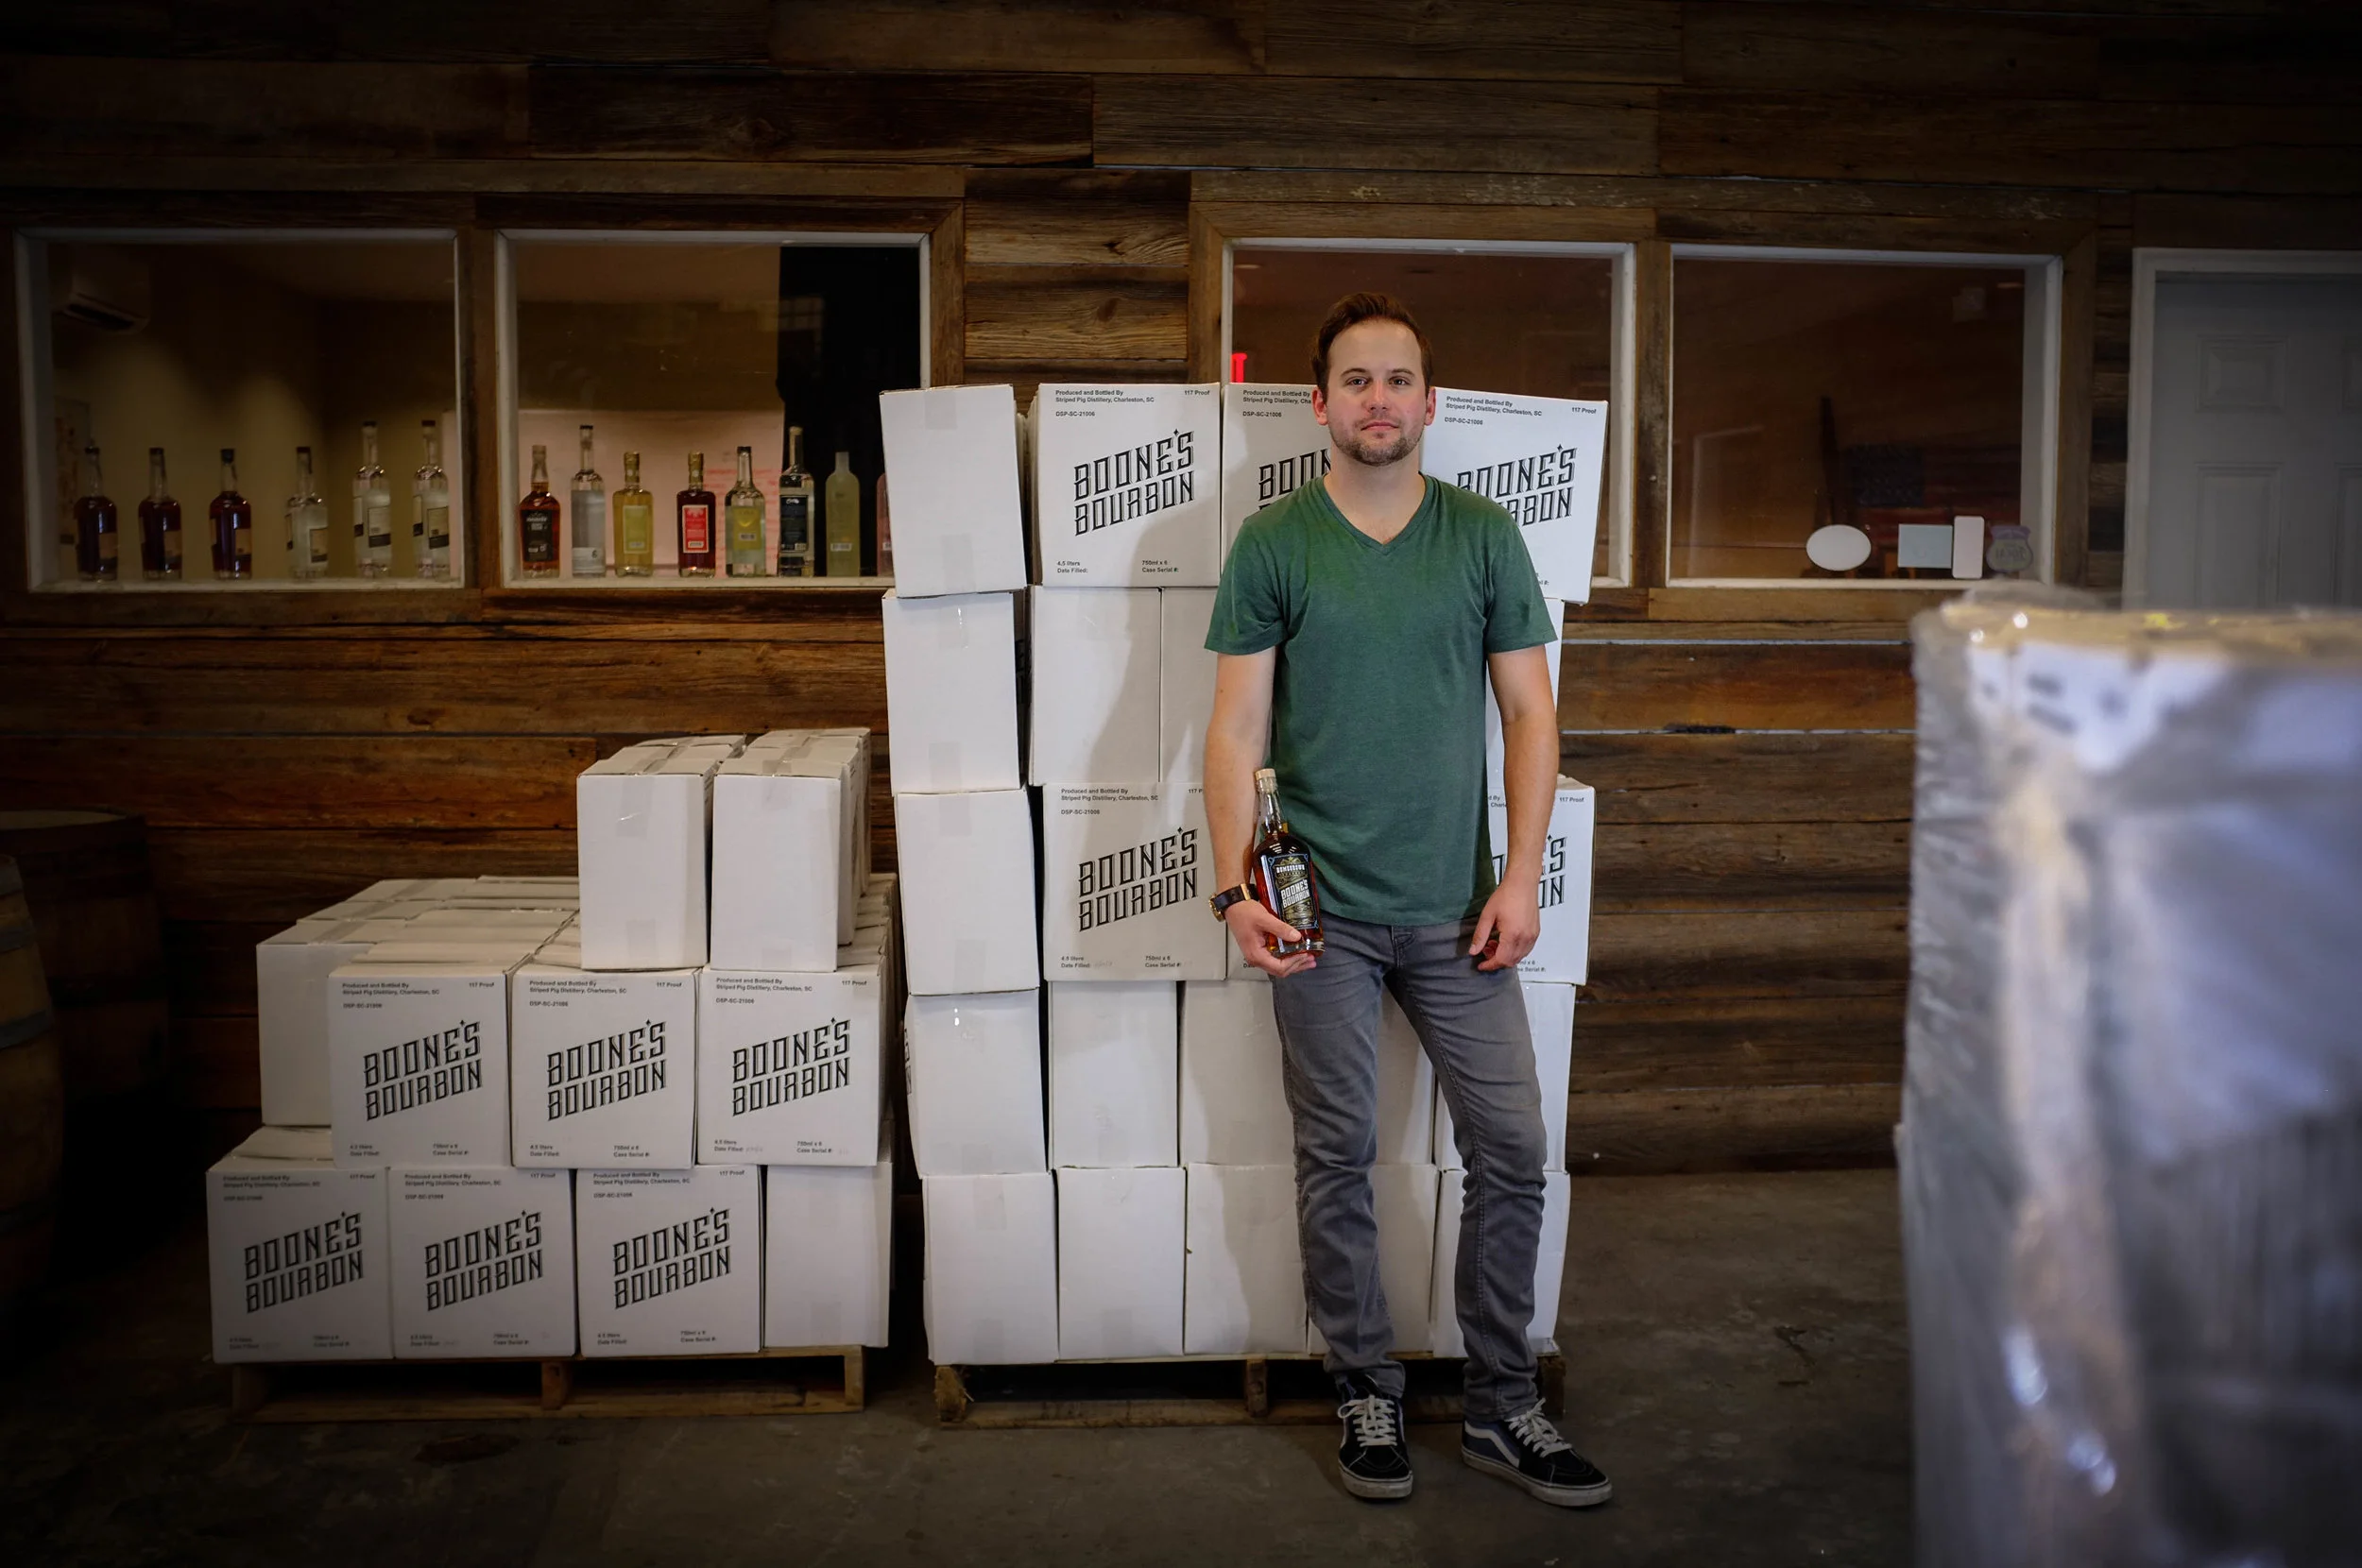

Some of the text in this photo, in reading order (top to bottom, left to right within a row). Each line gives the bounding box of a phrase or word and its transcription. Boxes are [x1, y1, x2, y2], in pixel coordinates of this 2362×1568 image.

[1477, 405, 1501, 414] Distillery,
[1074, 429, 1194, 502] BOONE'S
[1074, 470, 1194, 537] BOURBON
[1498, 486, 1574, 526] RBON
[1078, 827, 1198, 898] BOONE'S
[1079, 868, 1198, 932] BOURBON
[363, 1019, 481, 1089] BOONE'S
[547, 1018, 666, 1088] BOONE'S
[732, 1016, 851, 1084] BOONE'S
[366, 1059, 483, 1121] BOURBON
[547, 1060, 666, 1121] BOURBON
[731, 1057, 850, 1116] BOURBON
[244, 1210, 363, 1282] BOONE'S
[424, 1210, 542, 1279] BOONE'S
[613, 1206, 730, 1277] BOONE'S
[246, 1250, 364, 1314] BOURBON
[426, 1249, 543, 1312] BOURBON
[614, 1245, 731, 1309] BOURBON
